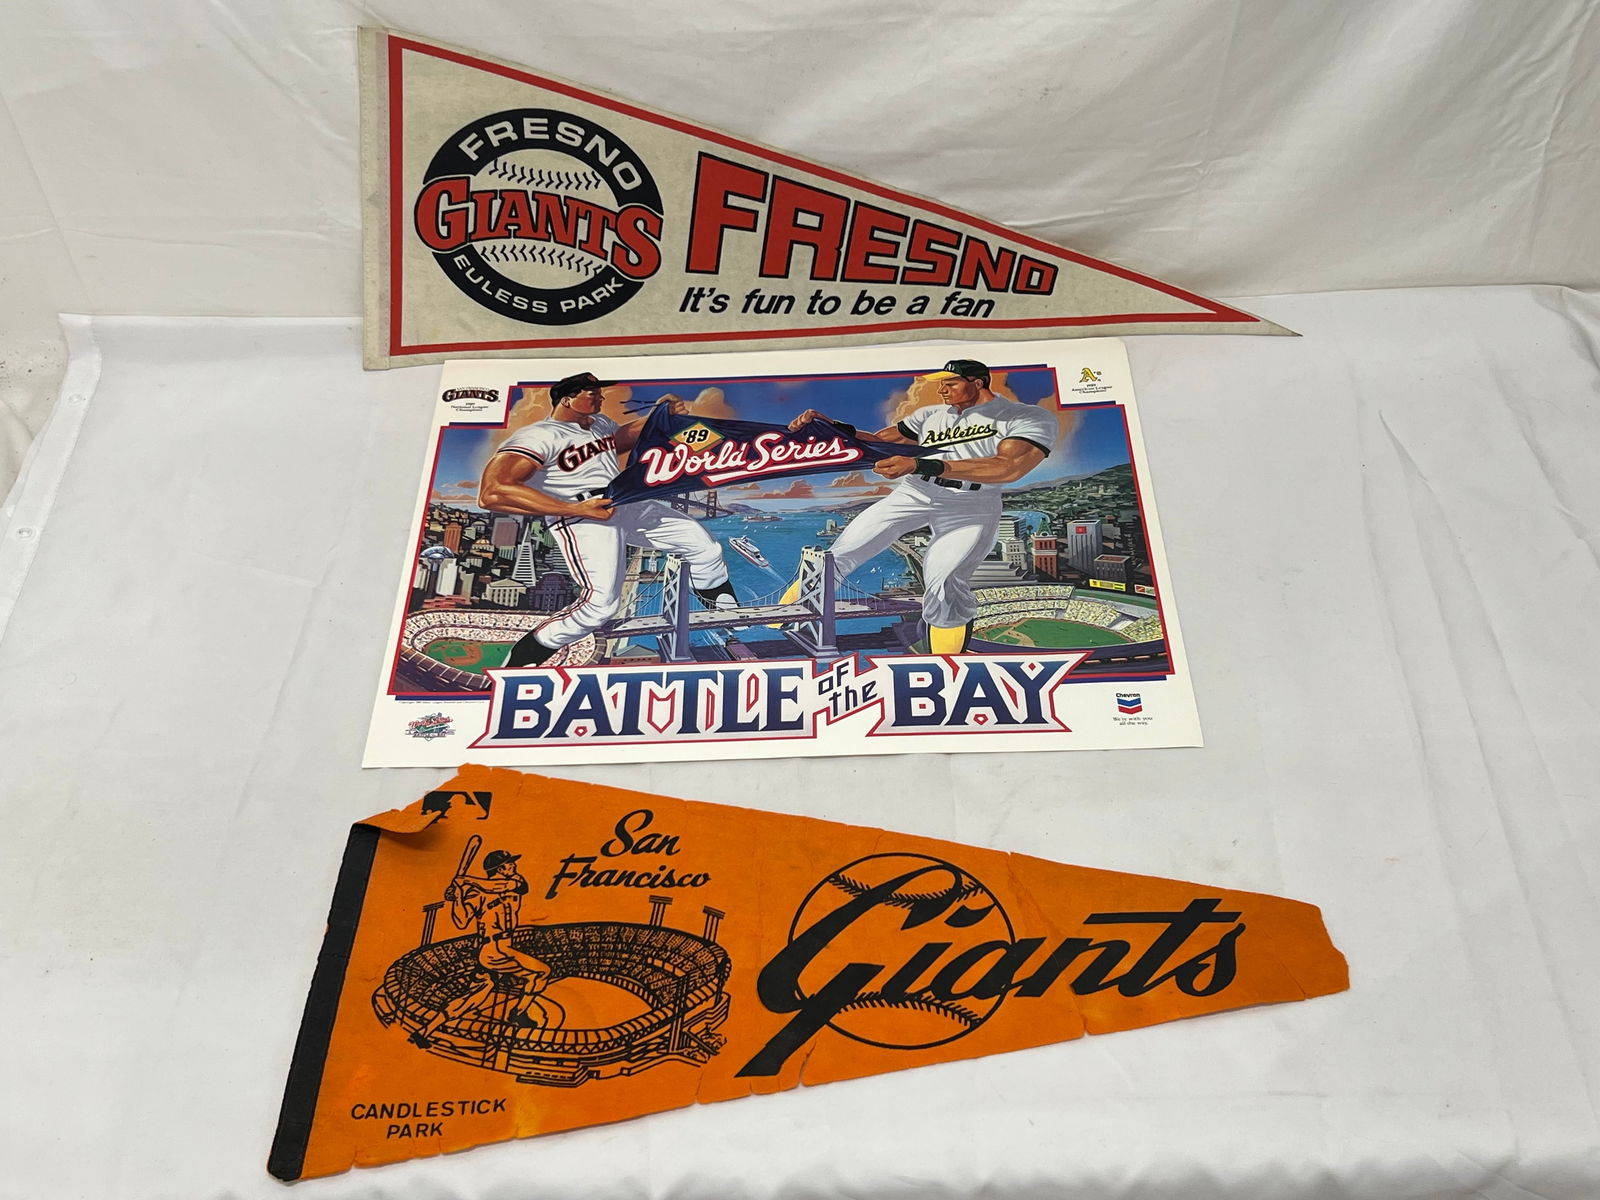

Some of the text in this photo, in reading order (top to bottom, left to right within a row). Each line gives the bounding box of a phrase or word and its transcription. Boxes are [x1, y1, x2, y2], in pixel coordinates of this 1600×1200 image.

[458, 117, 643, 192] FRESNO
[414, 176, 663, 280] GIANTS
[685, 150, 1059, 296] FRESNO
[453, 254, 624, 314] EULESS PARK
[679, 286, 996, 319] It's fun to be a fan
[442, 388, 499, 403] GIANTS
[640, 431, 863, 486] World Series
[683, 428, 709, 444] '89
[921, 424, 998, 446] Athletics
[490, 667, 804, 739] BATTLE
[829, 680, 878, 718] the
[889, 660, 1067, 727] BAY
[600, 809, 681, 859] San
[545, 852, 711, 900] Francisco
[734, 863, 1247, 1079] Giants
[351, 1098, 507, 1121] CANDLESTICK
[386, 1122, 444, 1140] PARK
